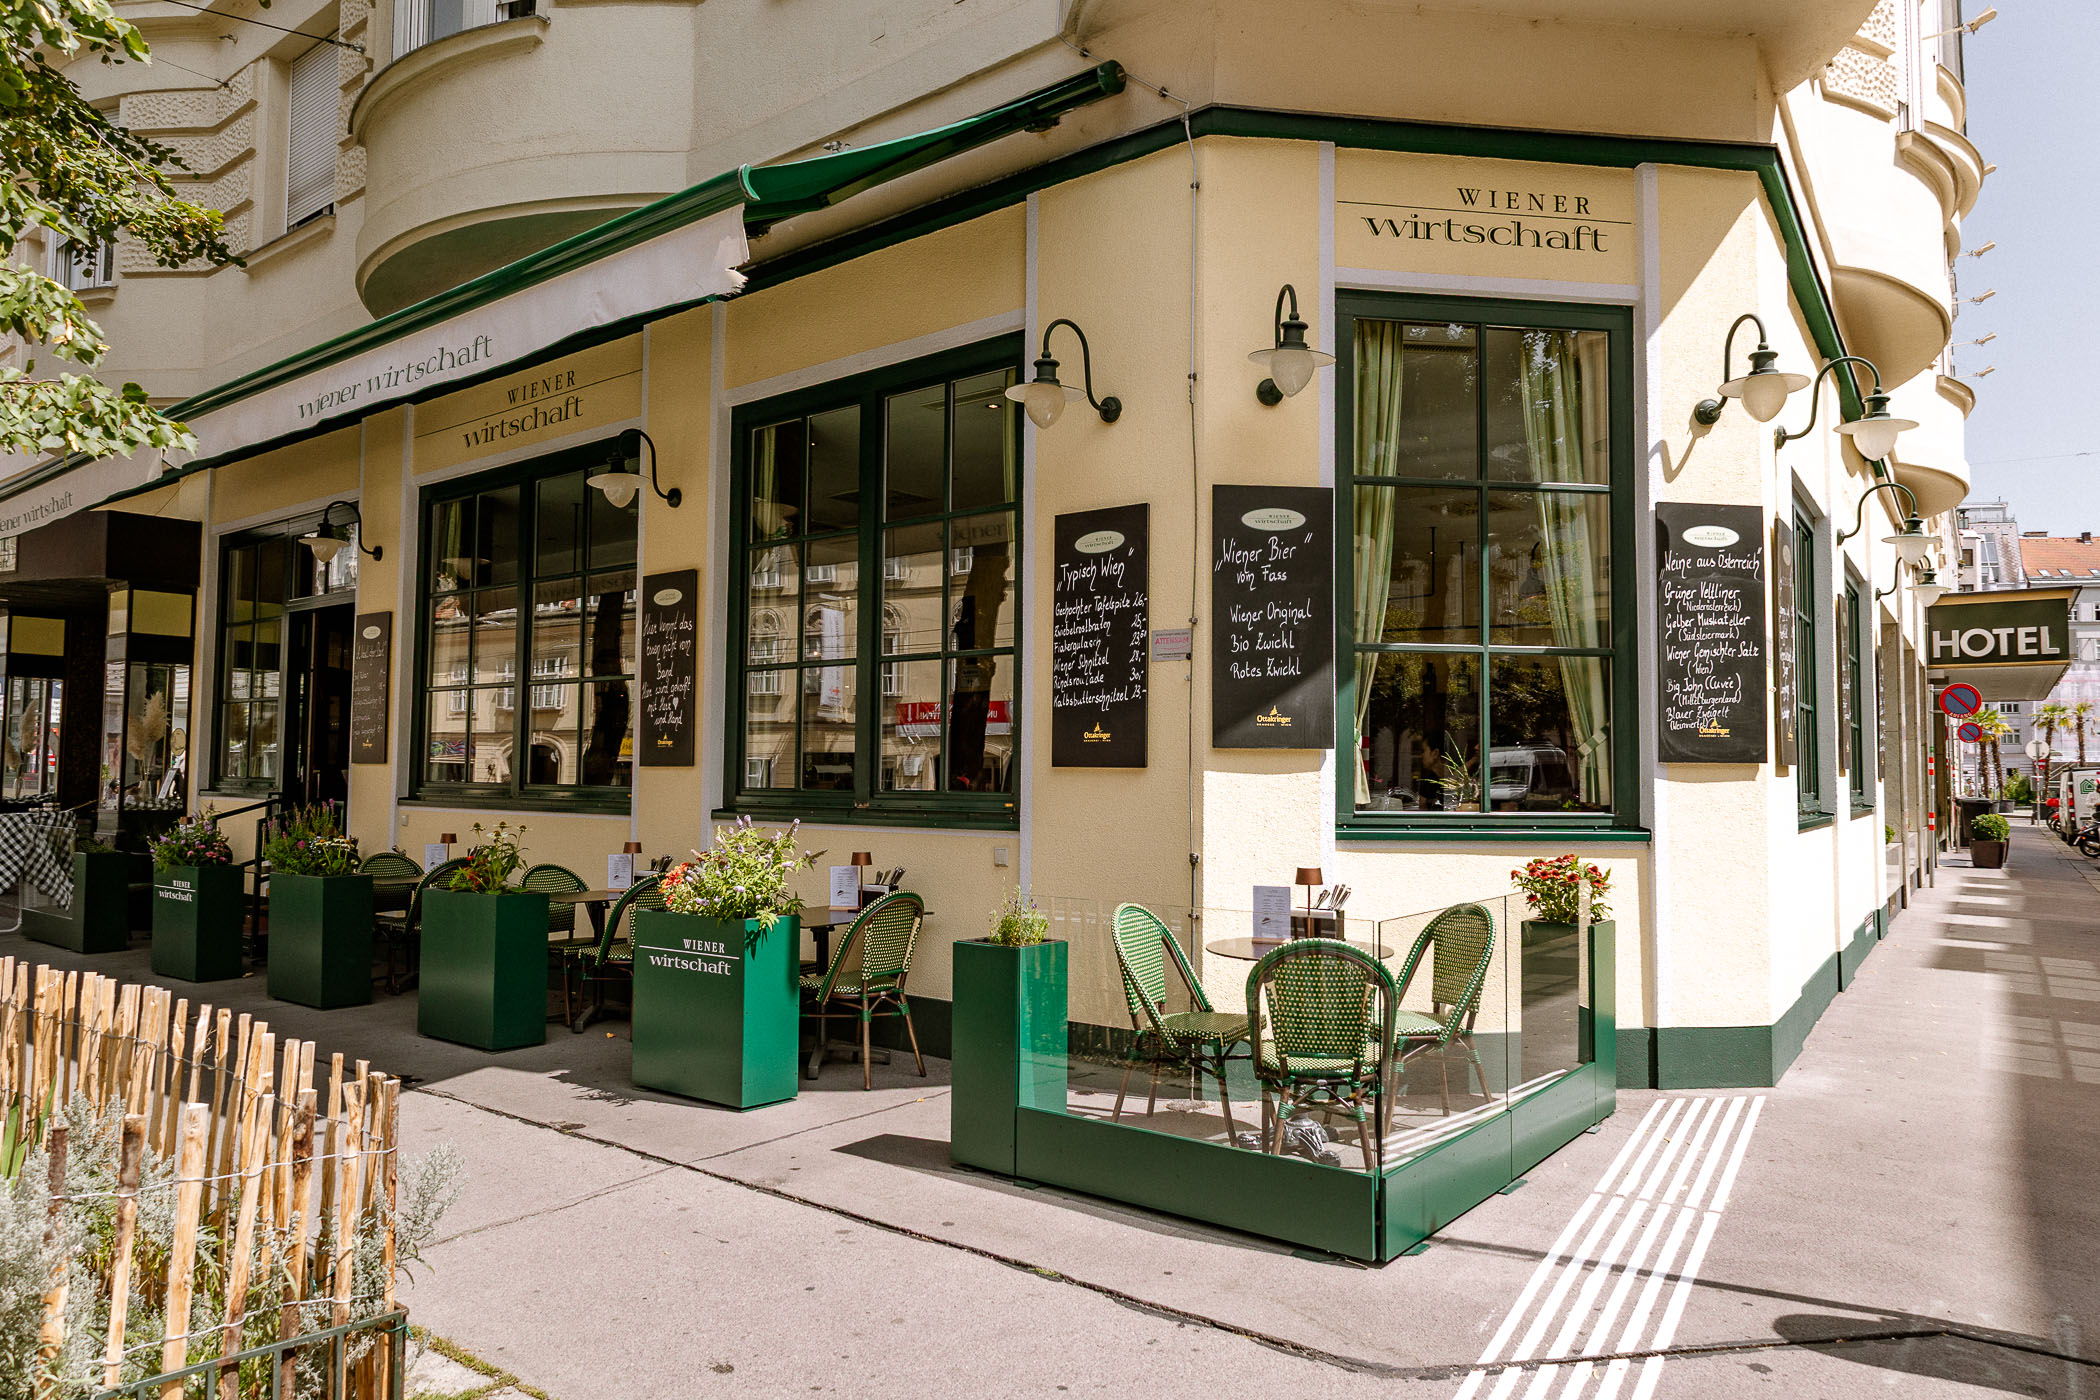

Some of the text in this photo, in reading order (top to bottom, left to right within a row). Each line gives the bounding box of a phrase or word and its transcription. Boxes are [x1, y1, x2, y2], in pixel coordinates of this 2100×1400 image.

[1456, 187, 1591, 215] WIENER
[1361, 213, 1609, 252] wirtschaft
[297, 334, 493, 419] wiener wirtschaft
[506, 370, 576, 405] WIENER
[463, 396, 584, 448] wirtschaft
[0, 491, 73, 531] ener wirtschaft
[1697, 558, 1716, 567] aus
[1236, 564, 1287, 591] vom Fass
[1094, 592, 1131, 618] Tafelspitz
[1664, 581, 1740, 606] Grüner Veltliner
[679, 612, 693, 630] das
[1230, 597, 1312, 631] Wiener Original
[1665, 612, 1750, 639] Gelber Muskateller
[1230, 630, 1295, 652] Bio Zwickl
[1666, 641, 1759, 666] Wiener Gemischter Satz
[1932, 626, 2060, 658] HOTEL
[1054, 658, 1075, 676] Wiener
[1078, 647, 1109, 675] Schnitzel
[1230, 656, 1301, 679] Rotes Zwickl
[1666, 679, 1680, 700] Big
[1683, 677, 1703, 696] John
[1666, 707, 1693, 721] Blauer
[683, 938, 725, 953] WIENER
[649, 954, 732, 976] wirtschaft
